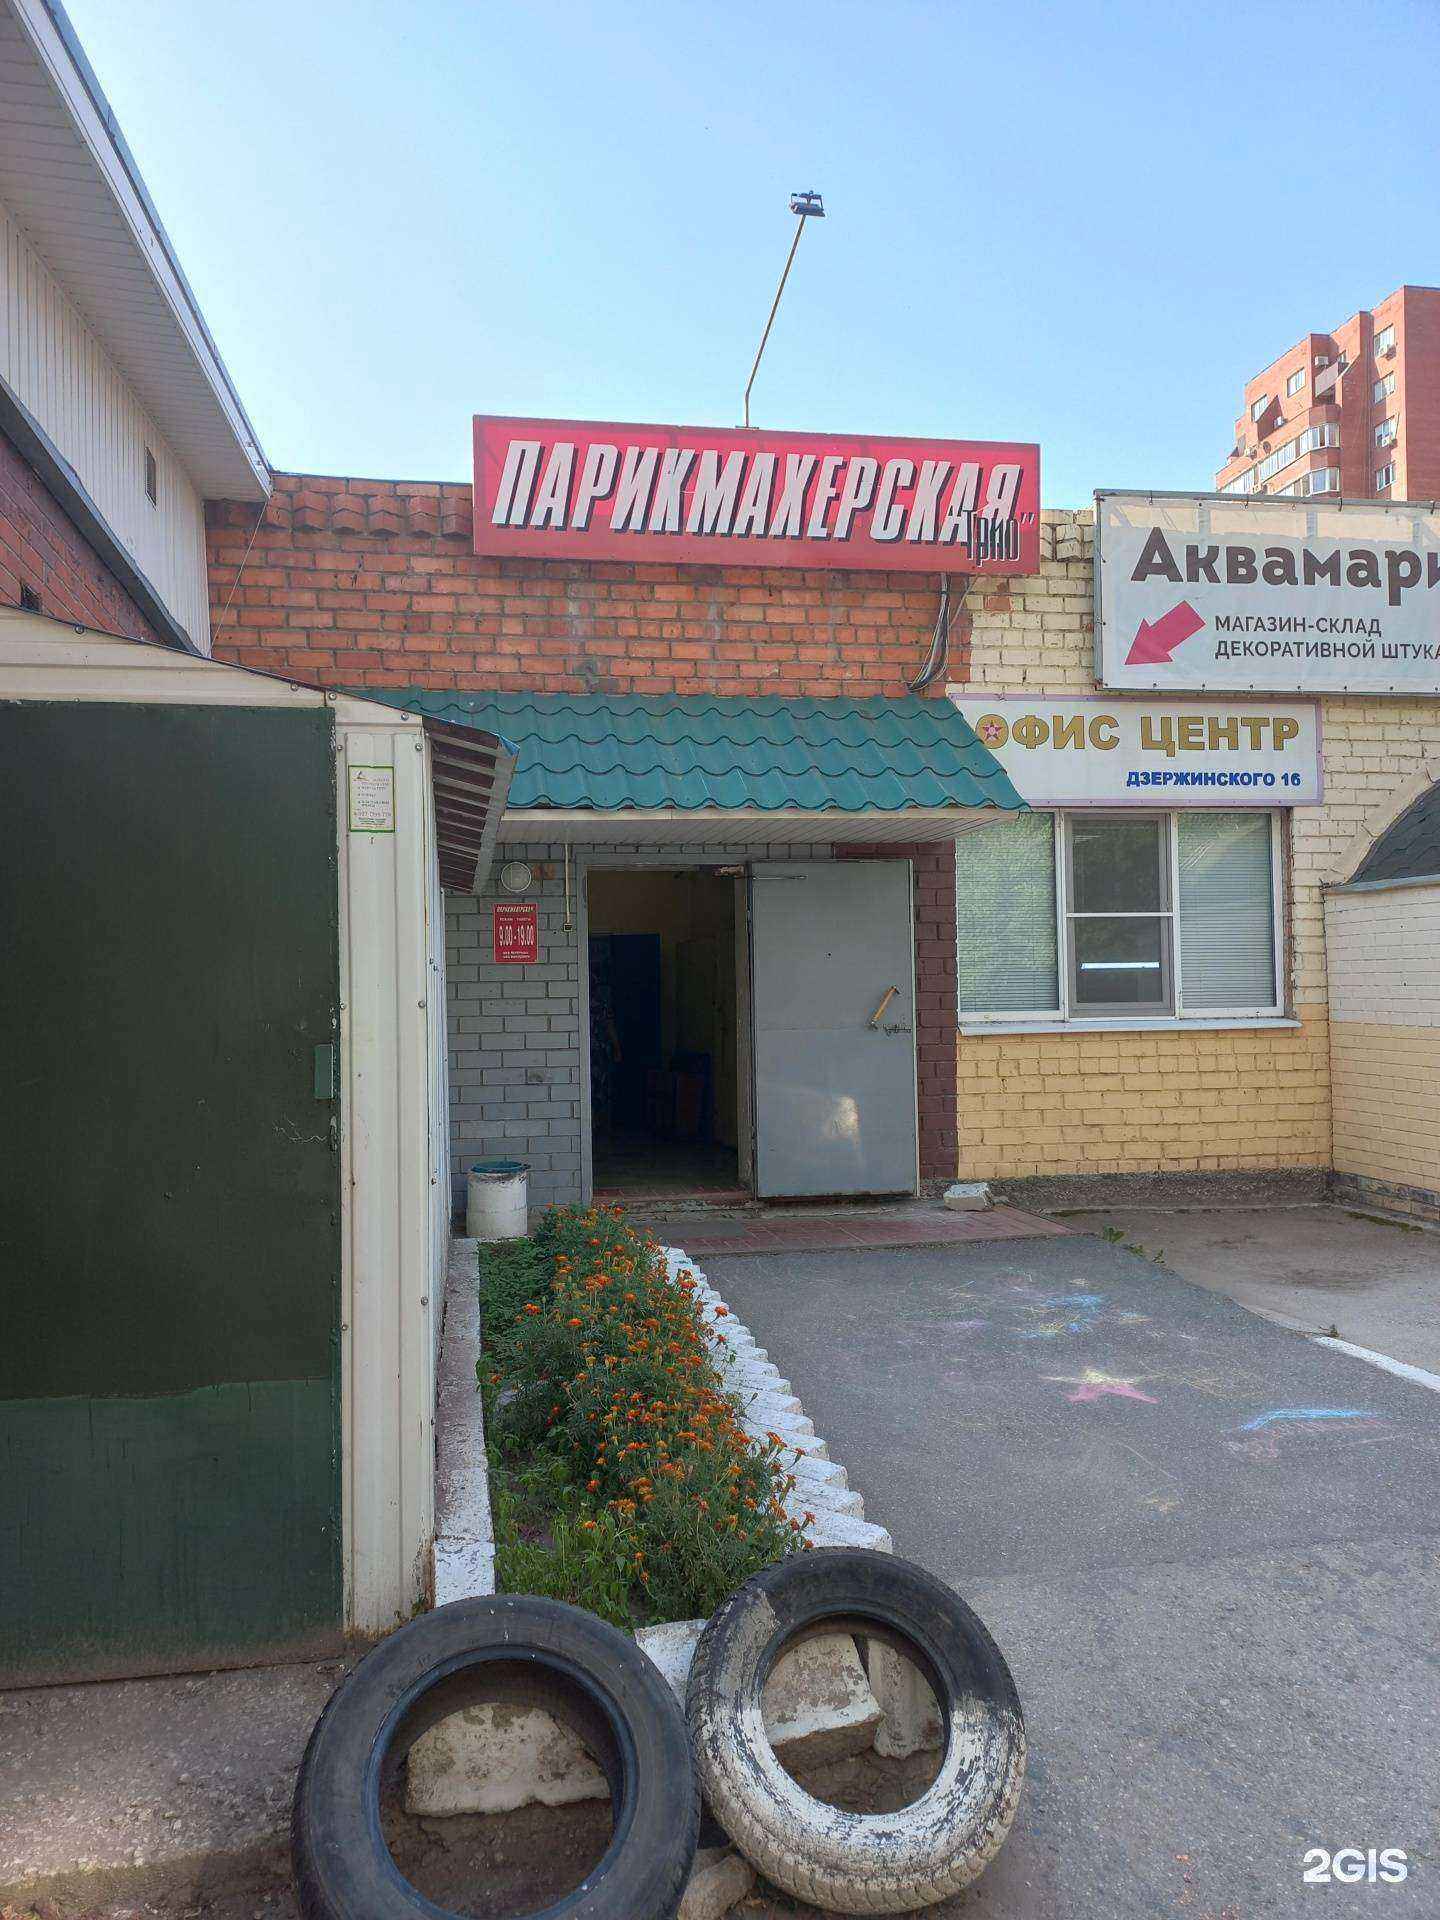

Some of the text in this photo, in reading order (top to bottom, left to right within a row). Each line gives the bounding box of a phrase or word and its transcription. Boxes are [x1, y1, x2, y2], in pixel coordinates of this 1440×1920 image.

[491, 440, 1023, 545] ПАРИКМАХЕРСКАЯ
[1215, 615, 1382, 638] МАГАЗИН-СКЛАД
[1215, 639, 1375, 660] ДЕКОРАТИВНОЙ
[976, 714, 1300, 757] ОФИС ЦЕНТР
[1126, 771, 1301, 787] ДЗЕРЖИНСКОГО 16
